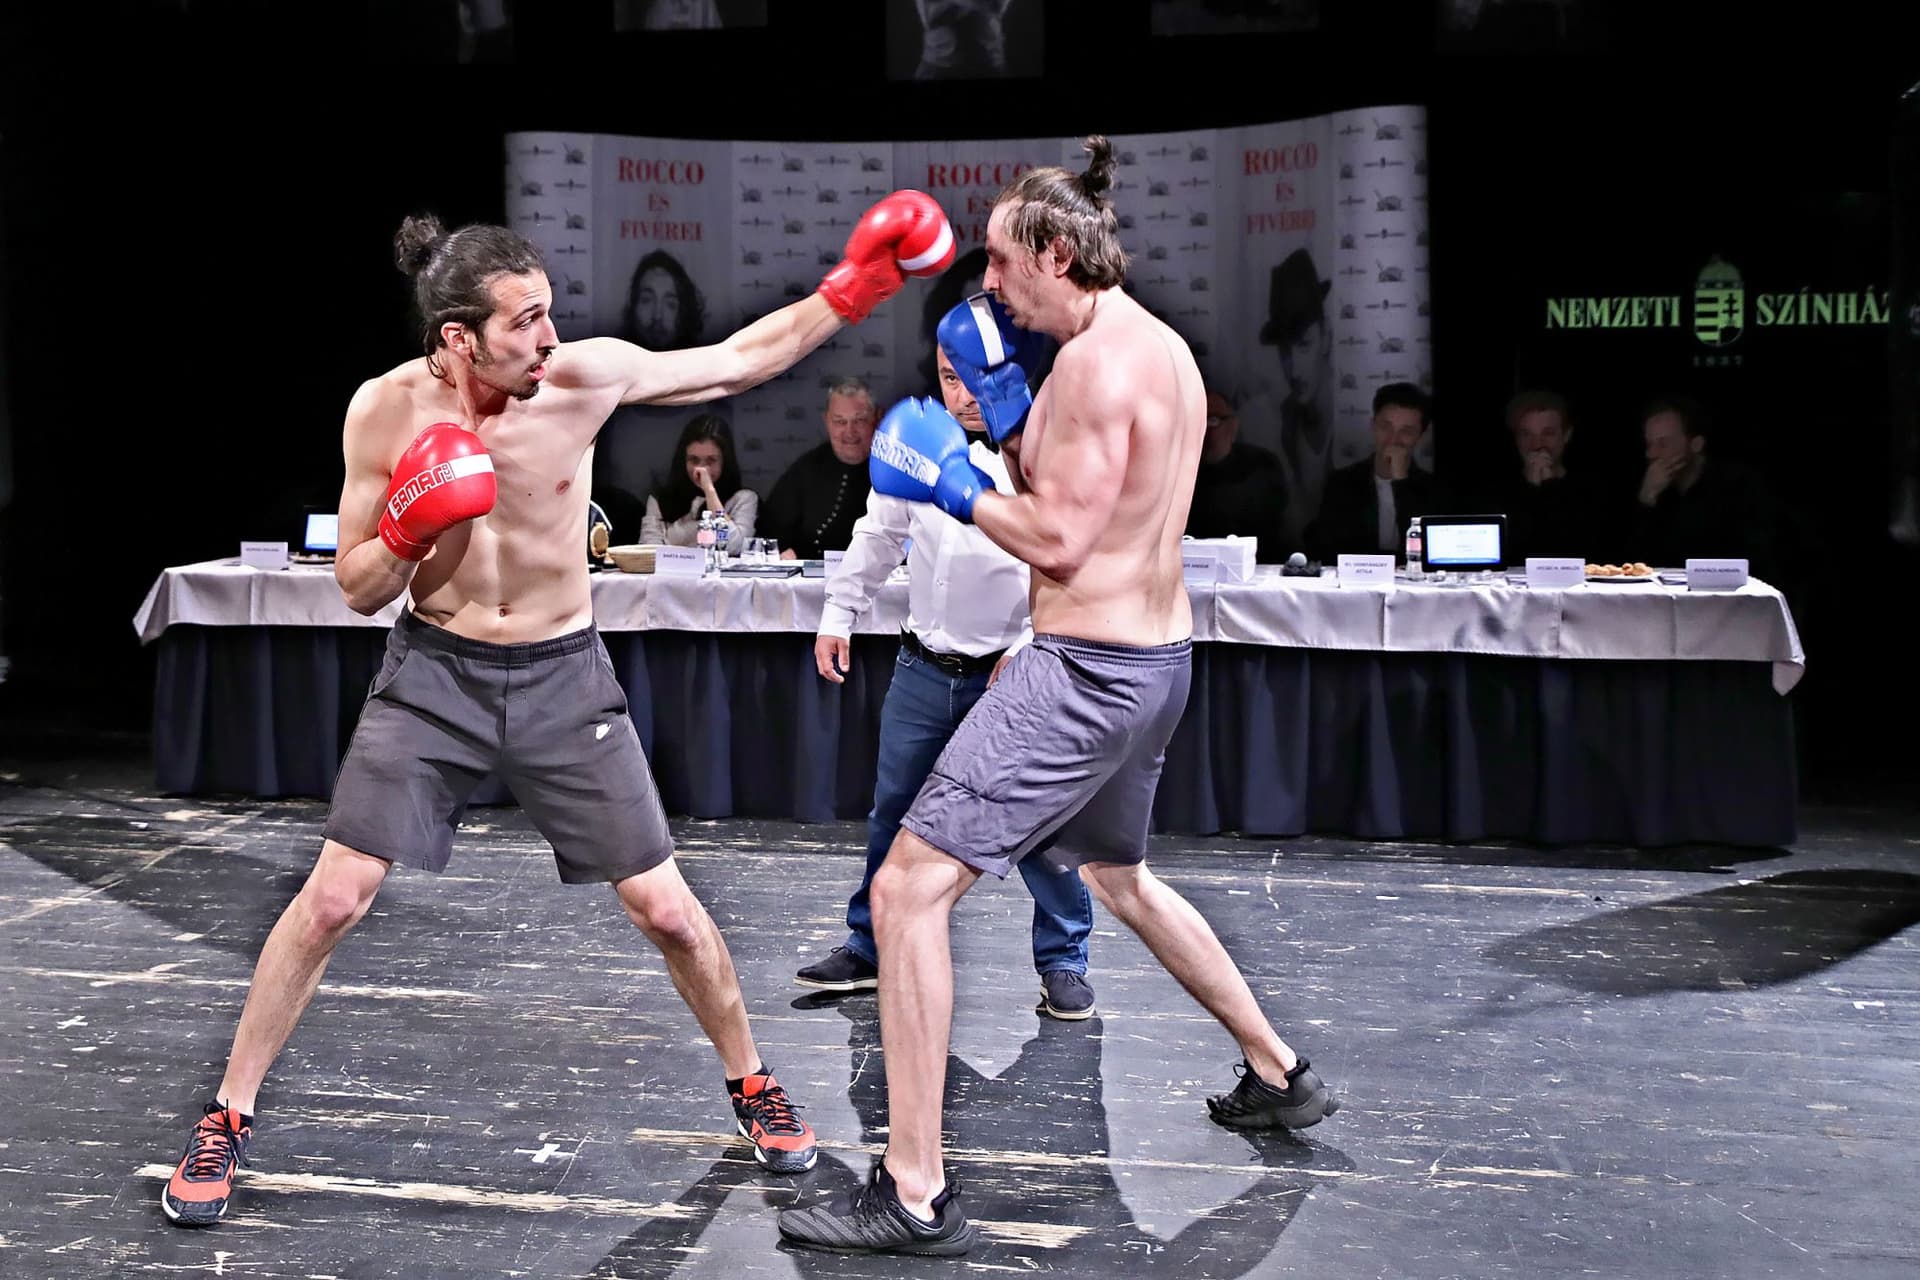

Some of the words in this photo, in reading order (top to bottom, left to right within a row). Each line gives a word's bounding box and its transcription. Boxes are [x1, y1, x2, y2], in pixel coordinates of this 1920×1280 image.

[618, 157, 705, 185] ROCCO
[1243, 143, 1319, 177] ROCCO
[1545, 295, 1683, 328] NEMZETI
